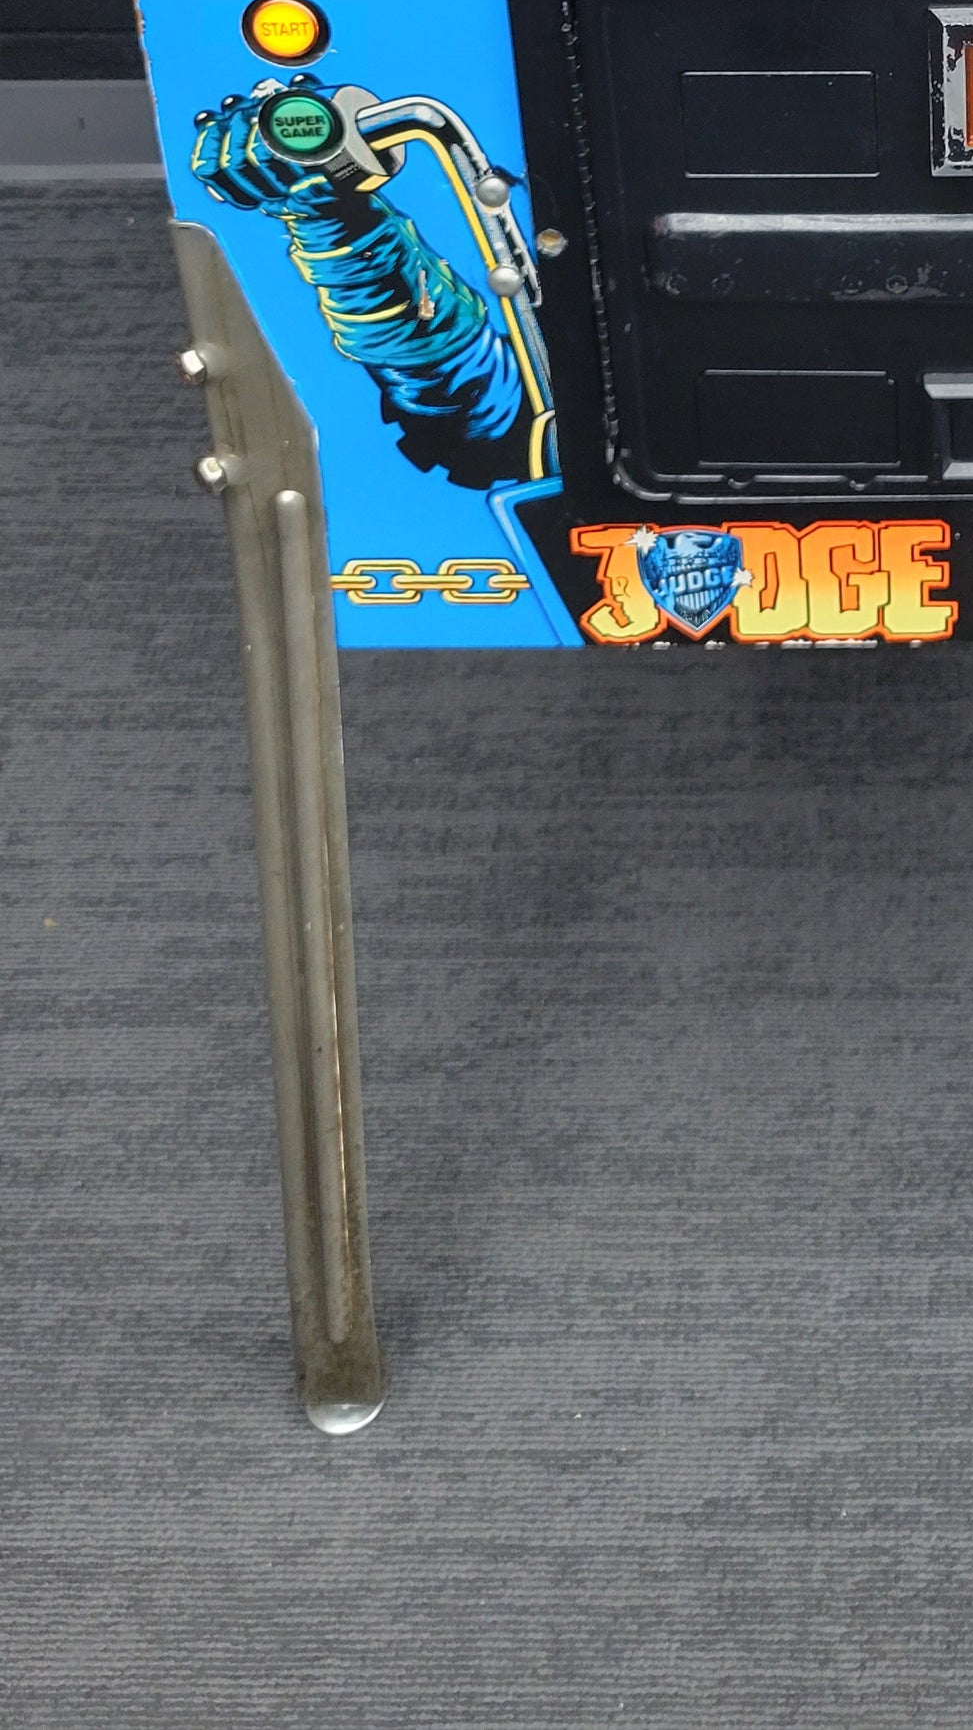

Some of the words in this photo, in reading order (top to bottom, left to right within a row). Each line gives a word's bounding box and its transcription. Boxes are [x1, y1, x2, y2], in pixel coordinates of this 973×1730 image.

[260, 22, 310, 37] START
[274, 115, 326, 127] SUPER
[280, 126, 325, 139] GAME
